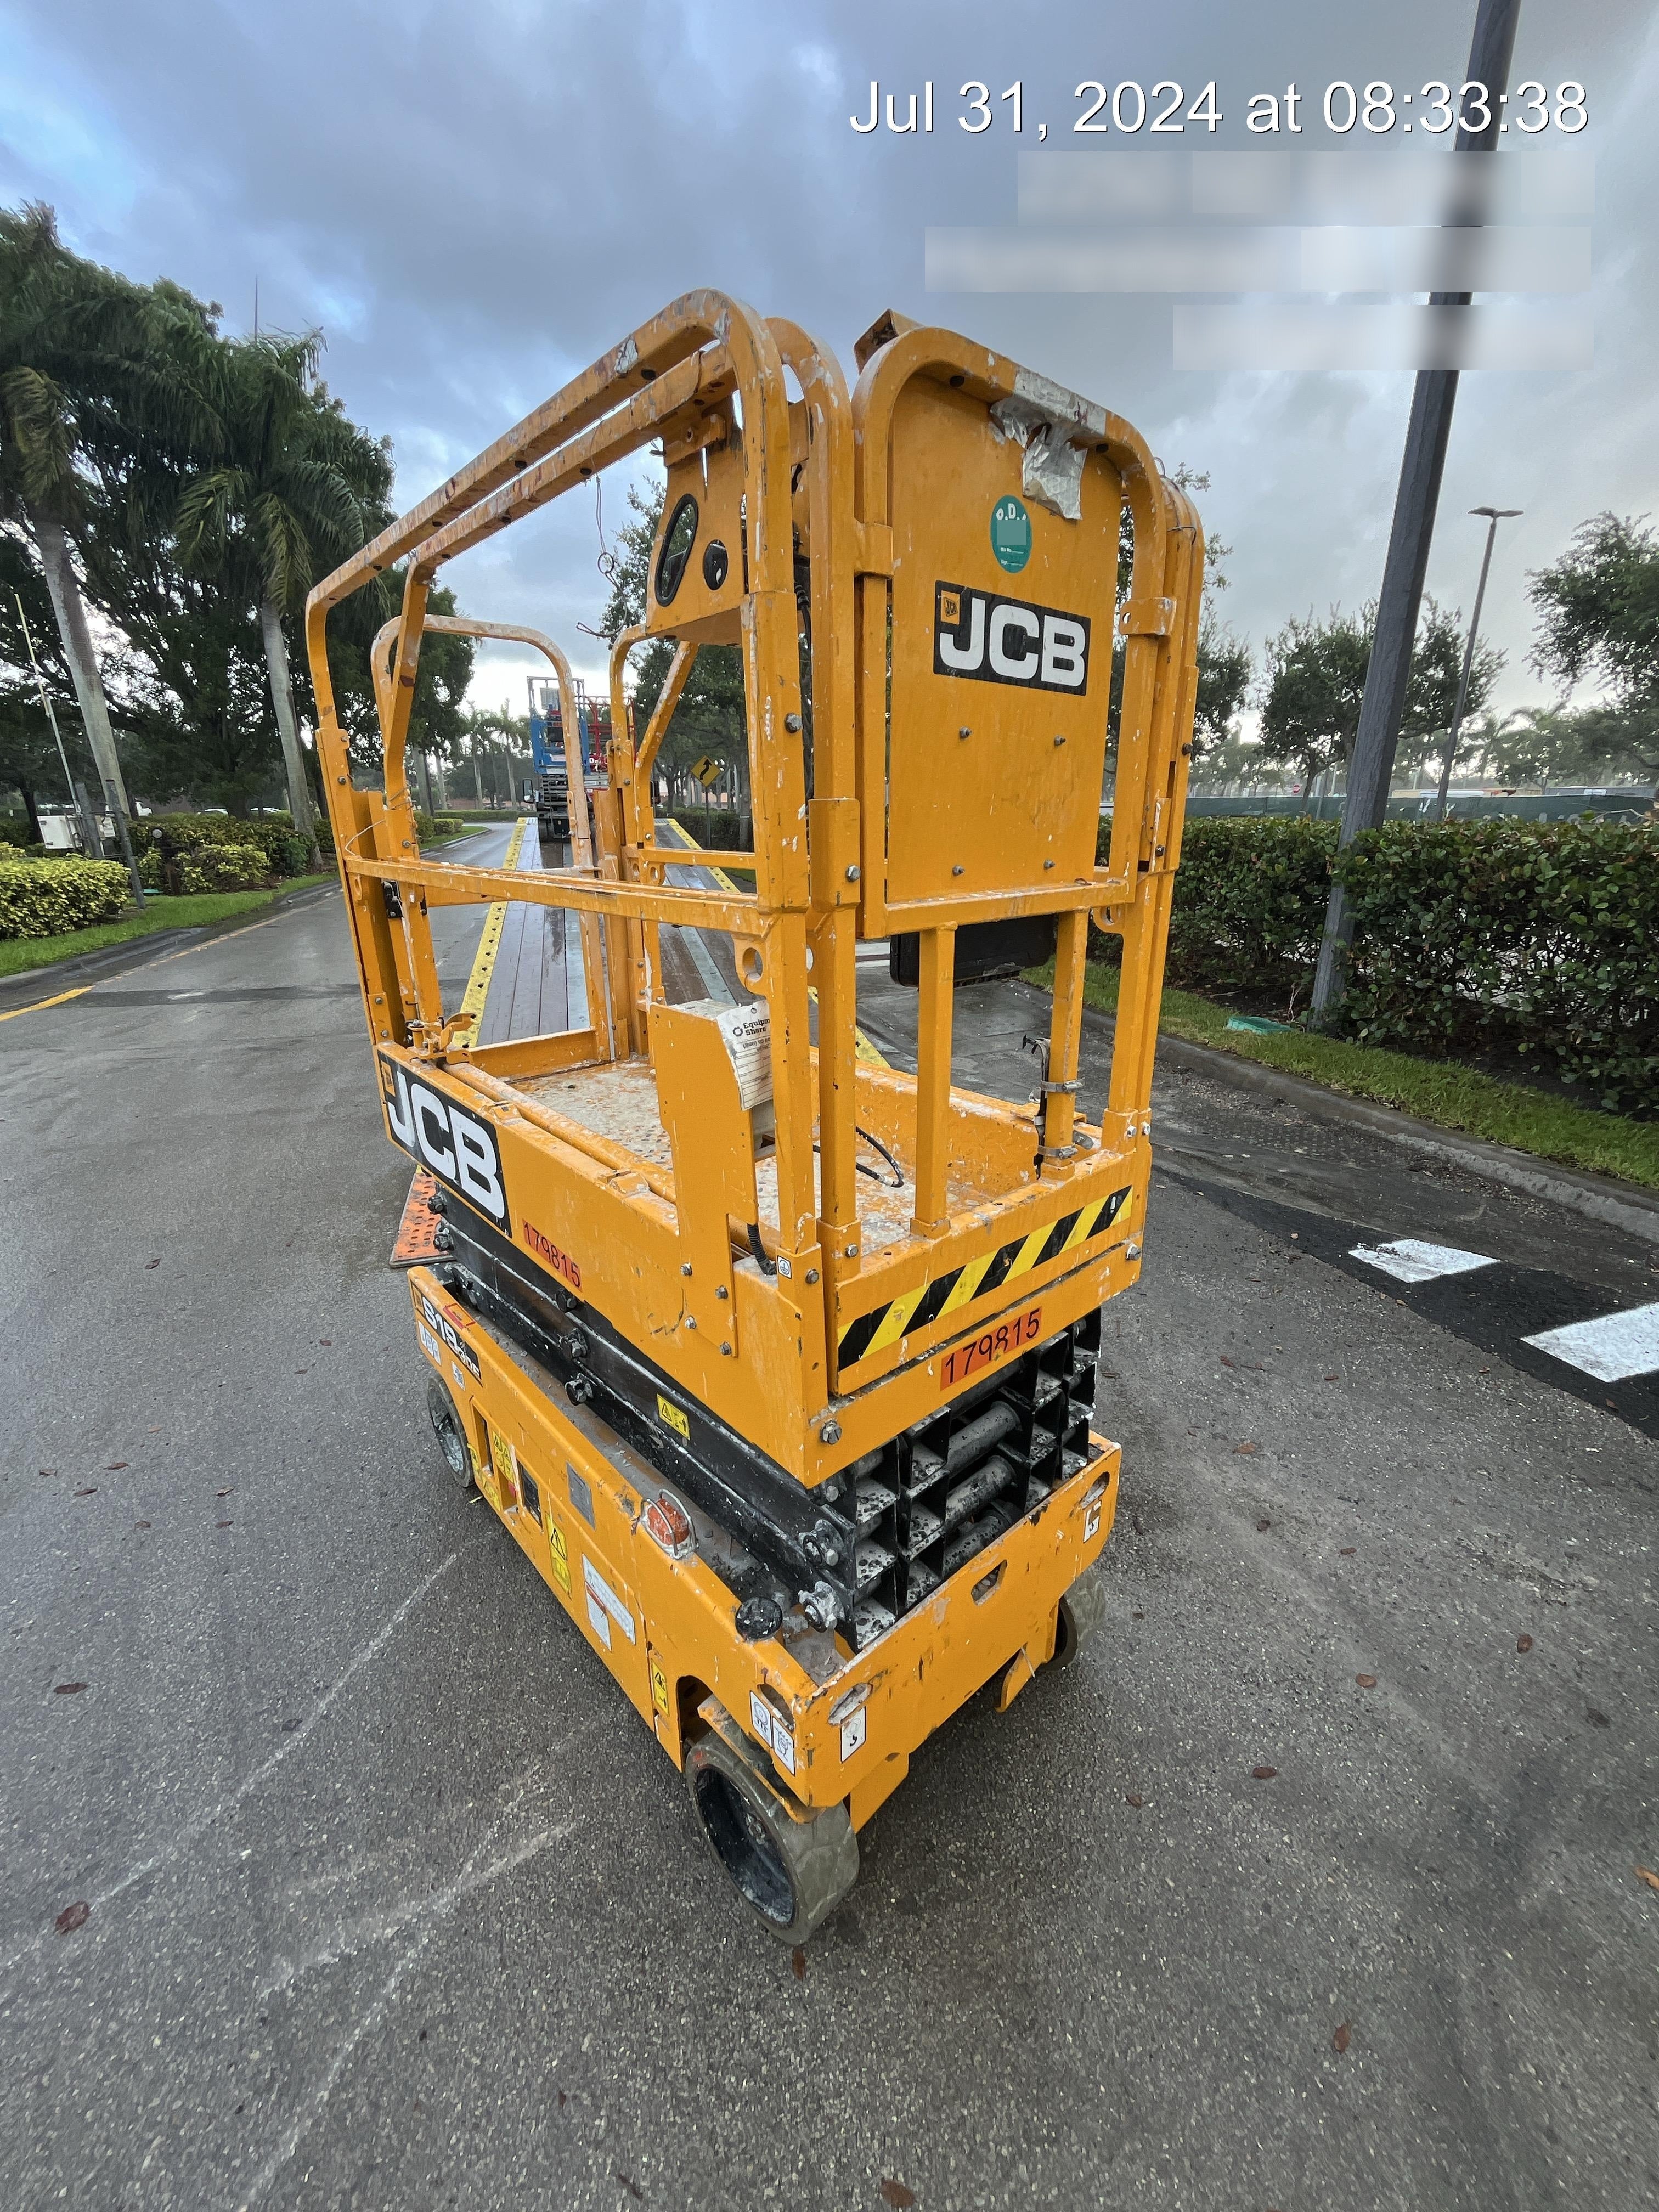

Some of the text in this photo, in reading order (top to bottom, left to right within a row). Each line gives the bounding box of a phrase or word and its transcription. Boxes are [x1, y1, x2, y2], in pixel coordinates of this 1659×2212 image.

[940, 597, 1085, 686] JCB
[745, 1026, 766, 1036] Share
[387, 1071, 506, 1219] JCB
[524, 1222, 580, 1288] 179815
[945, 1308, 1040, 1384] 179815
